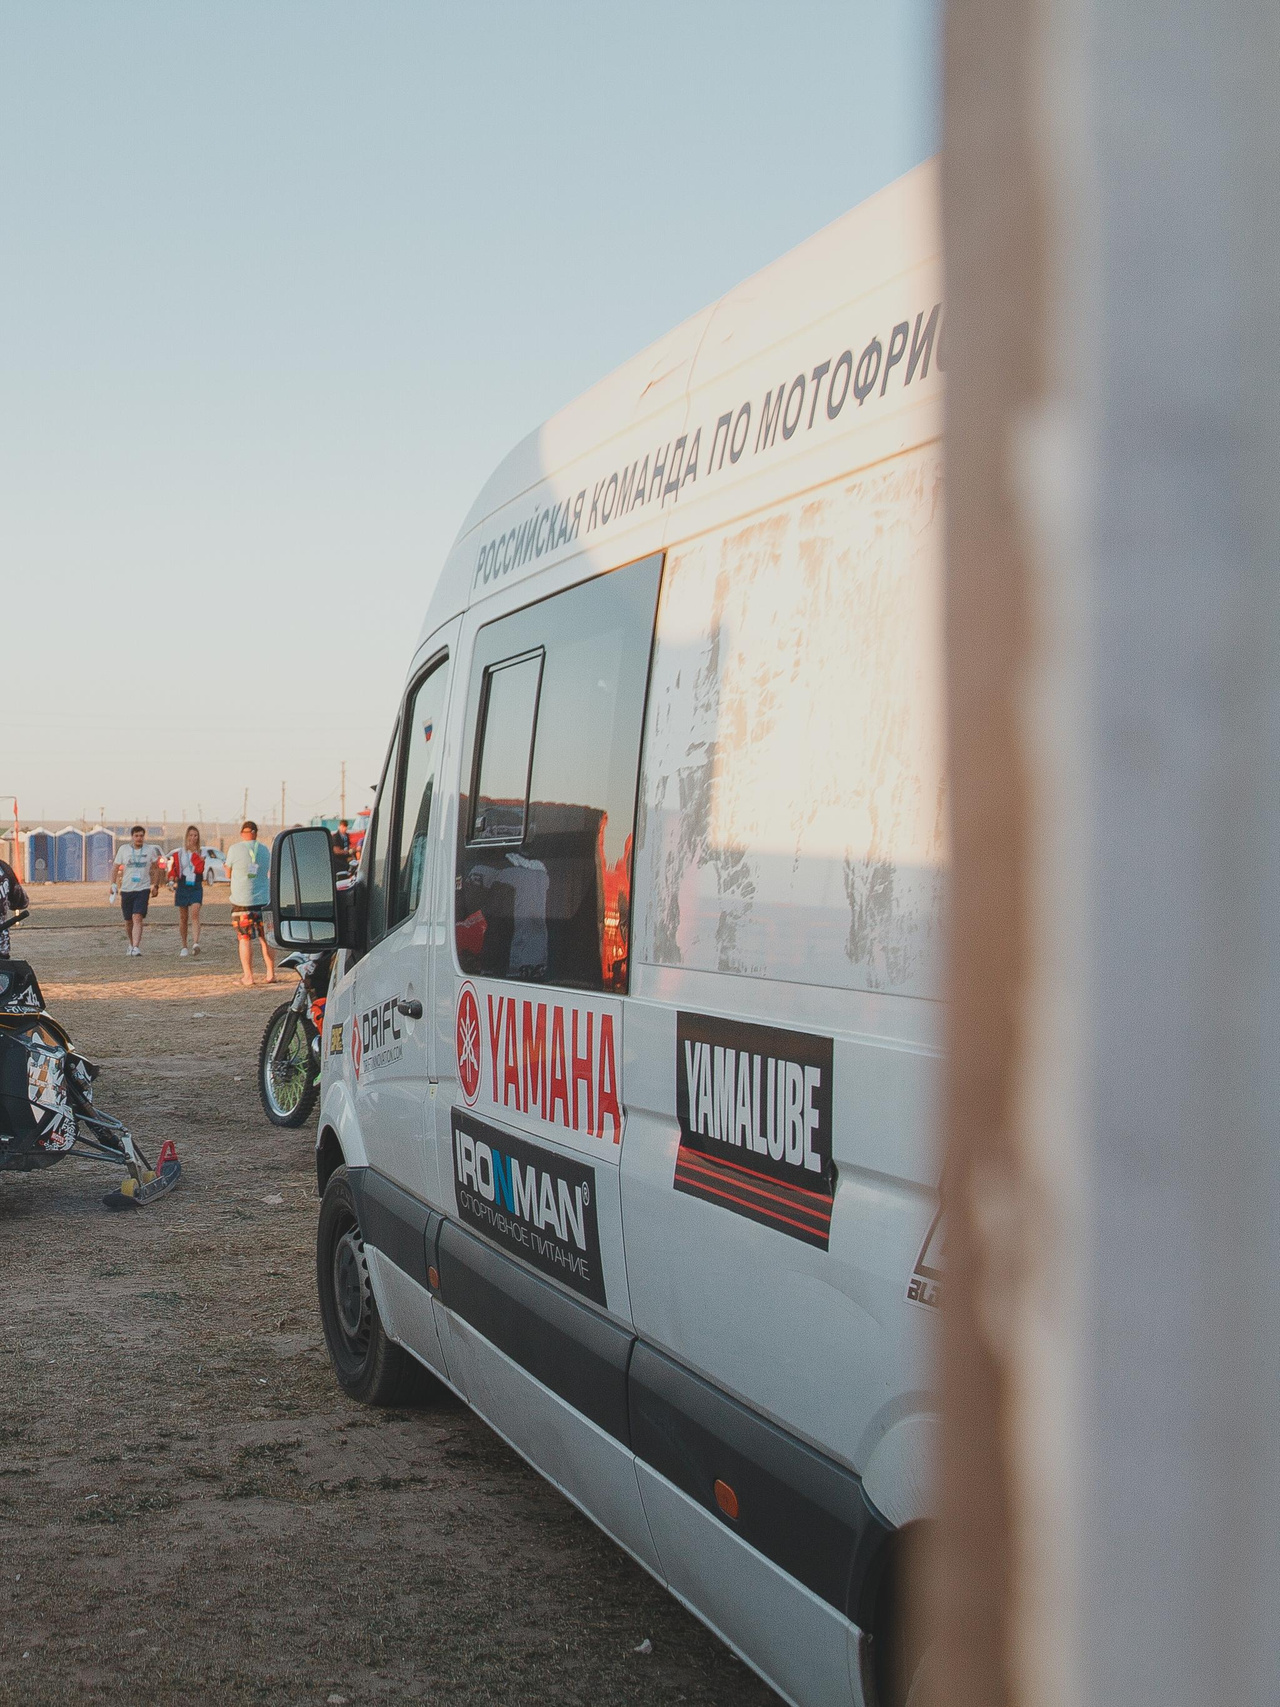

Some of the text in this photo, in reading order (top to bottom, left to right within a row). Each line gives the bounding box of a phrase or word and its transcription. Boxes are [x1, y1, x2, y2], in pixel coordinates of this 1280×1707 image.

[473, 488, 587, 590] РОССИЙСКАЯ
[586, 428, 703, 533] КОМАНДА
[707, 402, 752, 476] ПО
[487, 994, 620, 1144] YAMAHA
[684, 1039, 822, 1173] YAMALUBE
[460, 1190, 591, 1281] СПОРТИВНОЕ ПИТАНИЕ
